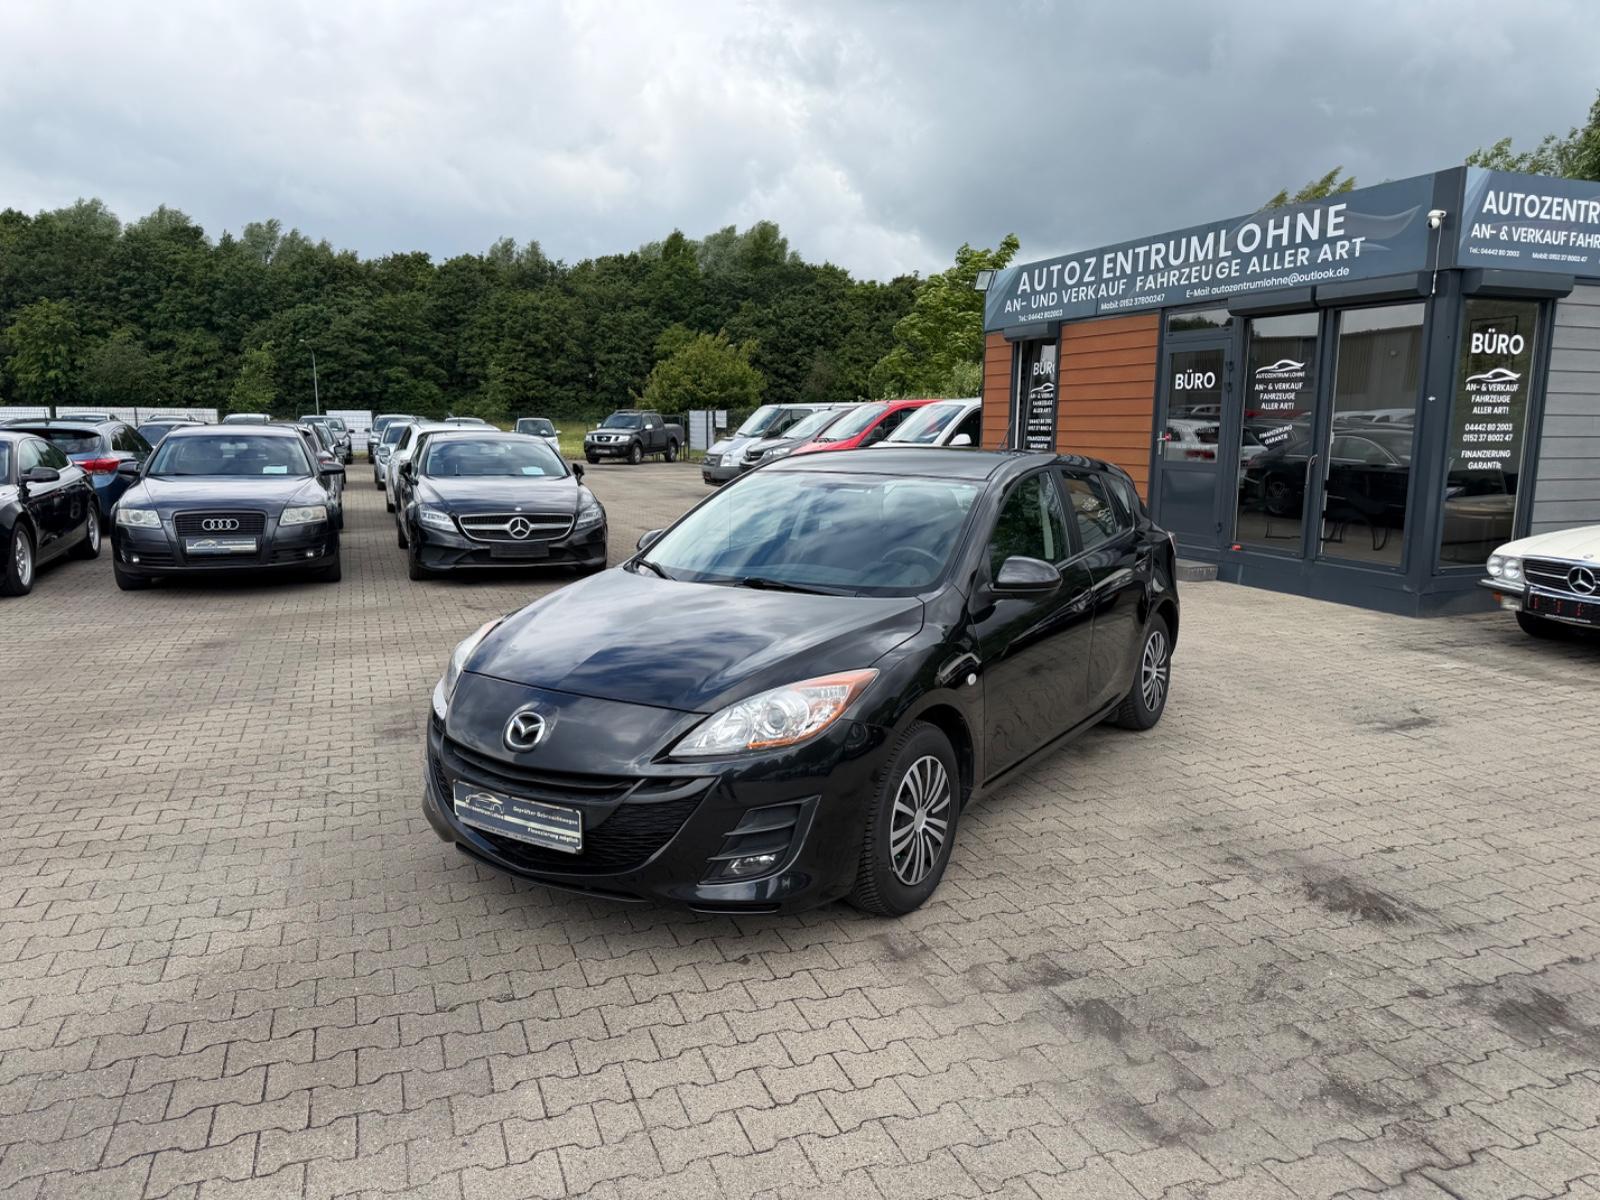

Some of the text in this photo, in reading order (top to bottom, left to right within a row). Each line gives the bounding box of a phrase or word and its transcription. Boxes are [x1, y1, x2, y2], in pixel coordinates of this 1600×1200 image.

[1482, 190, 1600, 224] AUTOZENTR
[1471, 223, 1497, 239] AN-
[1500, 226, 1508, 240] &
[1512, 226, 1568, 245] VERKAUF
[1004, 236, 1366, 313] AN- UND VERKAUF FAHRZEUGE ALLER ART
[1211, 266, 1350, 295] autozentrumlohne@outlook.de
[1470, 327, 1524, 355] BÜRO
[1174, 369, 1216, 390] BÜRO
[1275, 382, 1303, 390] VERKAUF
[1481, 383, 1487, 391] &
[1488, 383, 1519, 392] VERKAUF
[1260, 392, 1296, 400] FAHRZEUGE
[1471, 394, 1511, 403] FAHRZEUGE
[1261, 402, 1279, 410] ALLER
[1472, 406, 1509, 415] ALLER ART!
[1465, 423, 1513, 431] 04442 80 2003
[1462, 434, 1513, 442] 0152 37 8002 47
[1461, 450, 1511, 459] FINANZIERUNG
